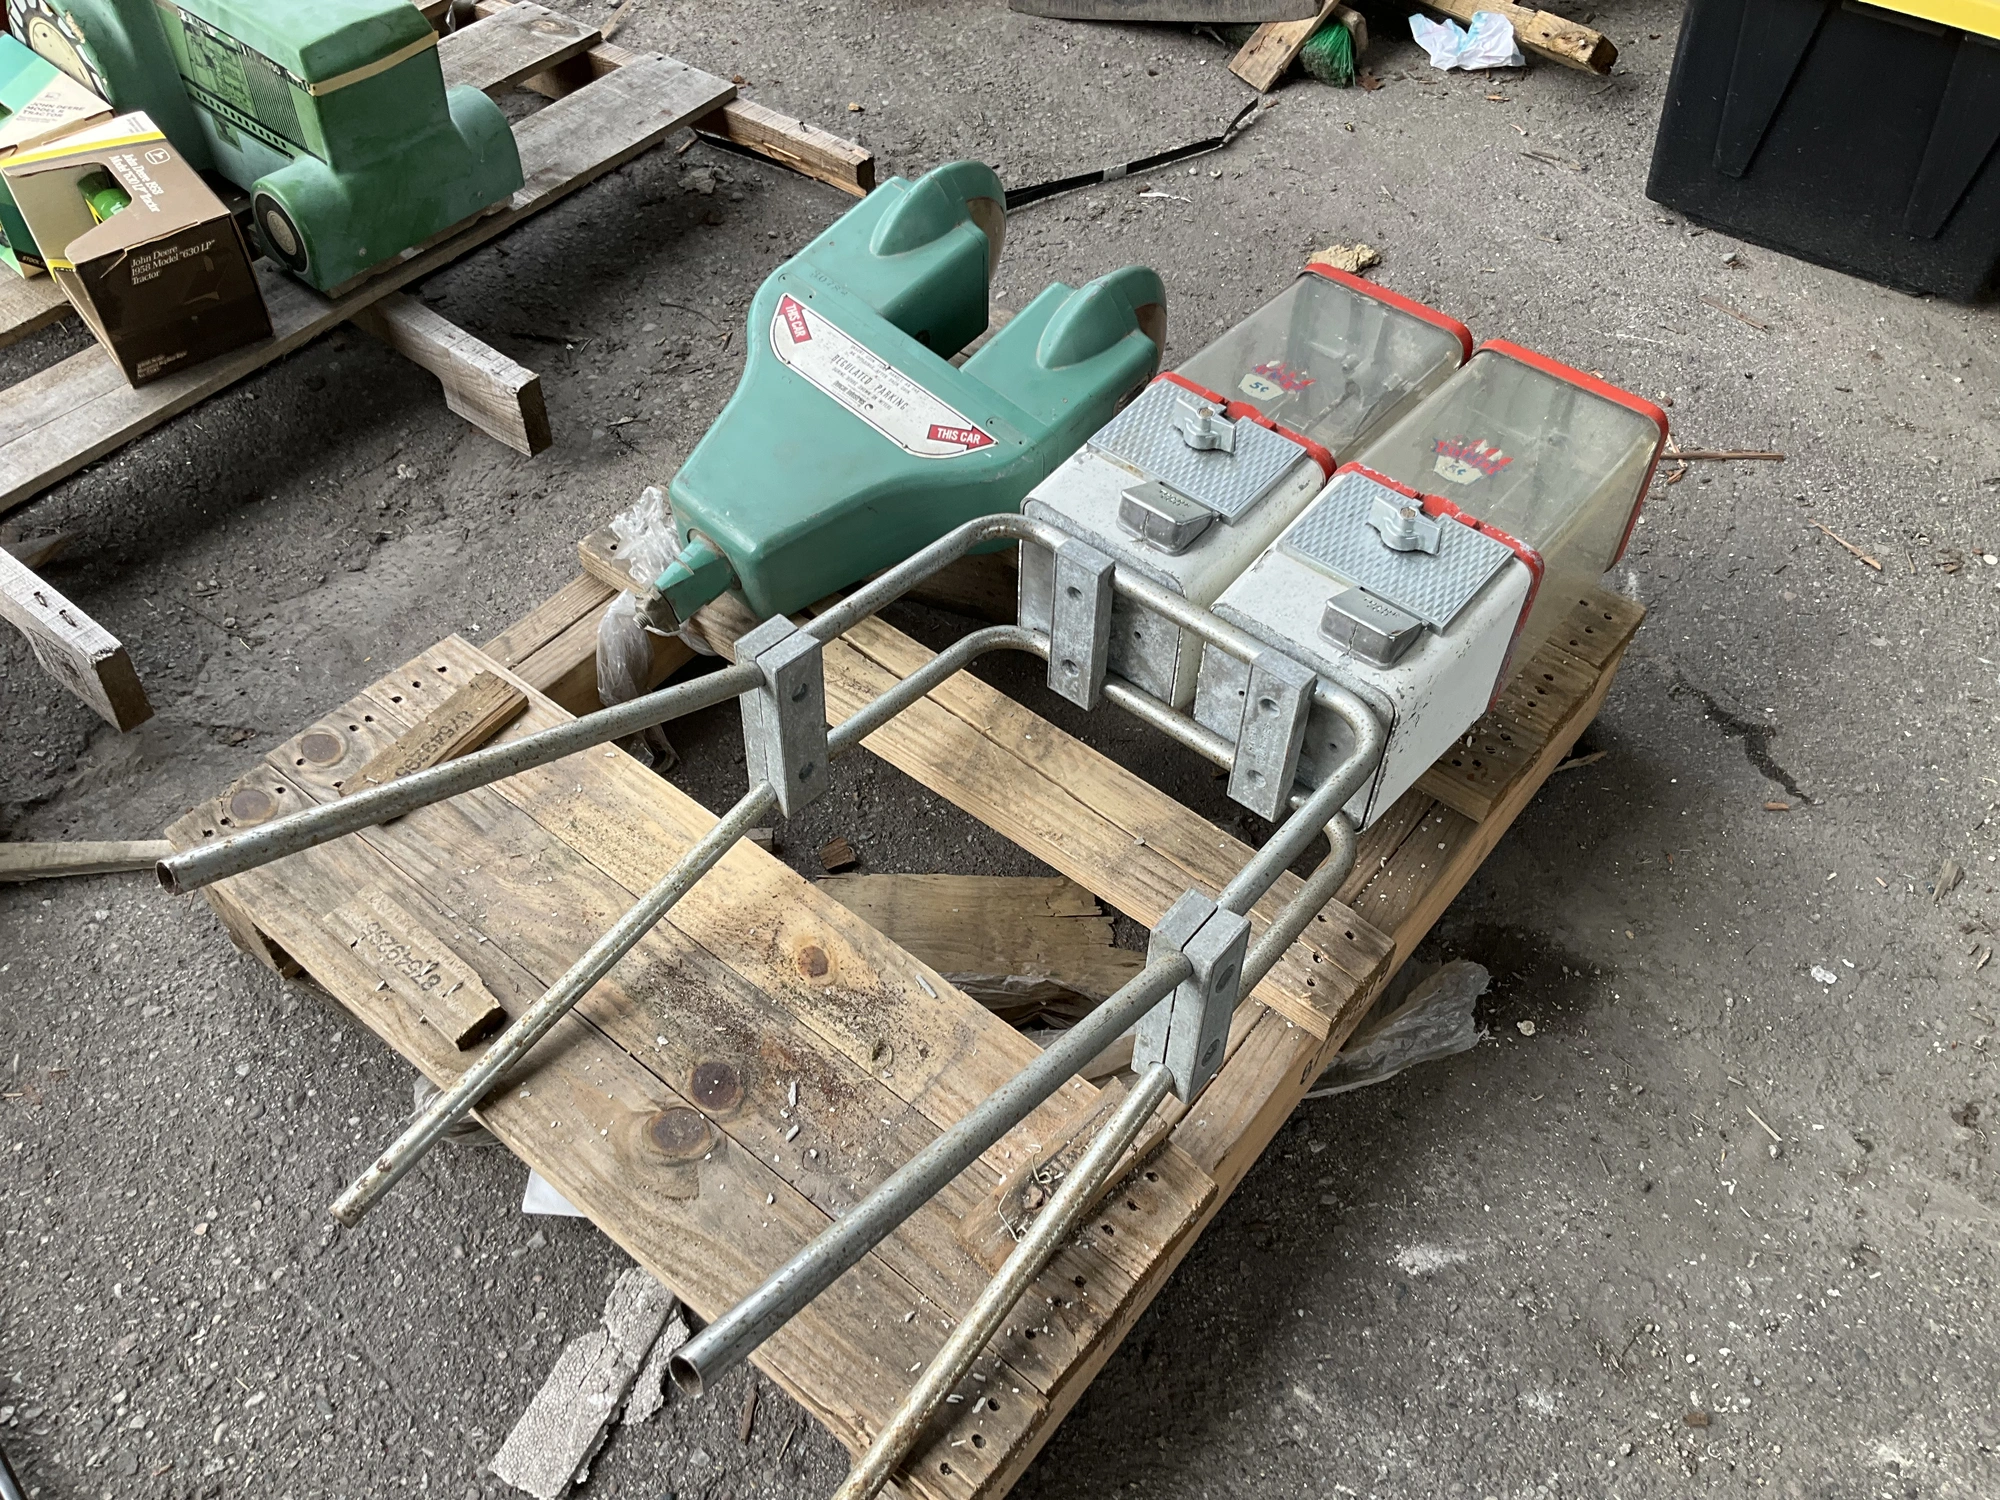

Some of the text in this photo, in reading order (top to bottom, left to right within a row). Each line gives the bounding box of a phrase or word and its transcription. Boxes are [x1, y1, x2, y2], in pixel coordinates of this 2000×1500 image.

[22, 256, 40, 264] STOCK
[132, 246, 178, 268] John Deere
[132, 263, 151, 277] 1958
[152, 253, 179, 269] Model
[132, 270, 160, 285] Tractor
[785, 304, 806, 338] THIS CAR
[874, 384, 908, 410] PARKING
[1249, 382, 1269, 393] 5¢
[937, 428, 980, 444] THIS CAR
